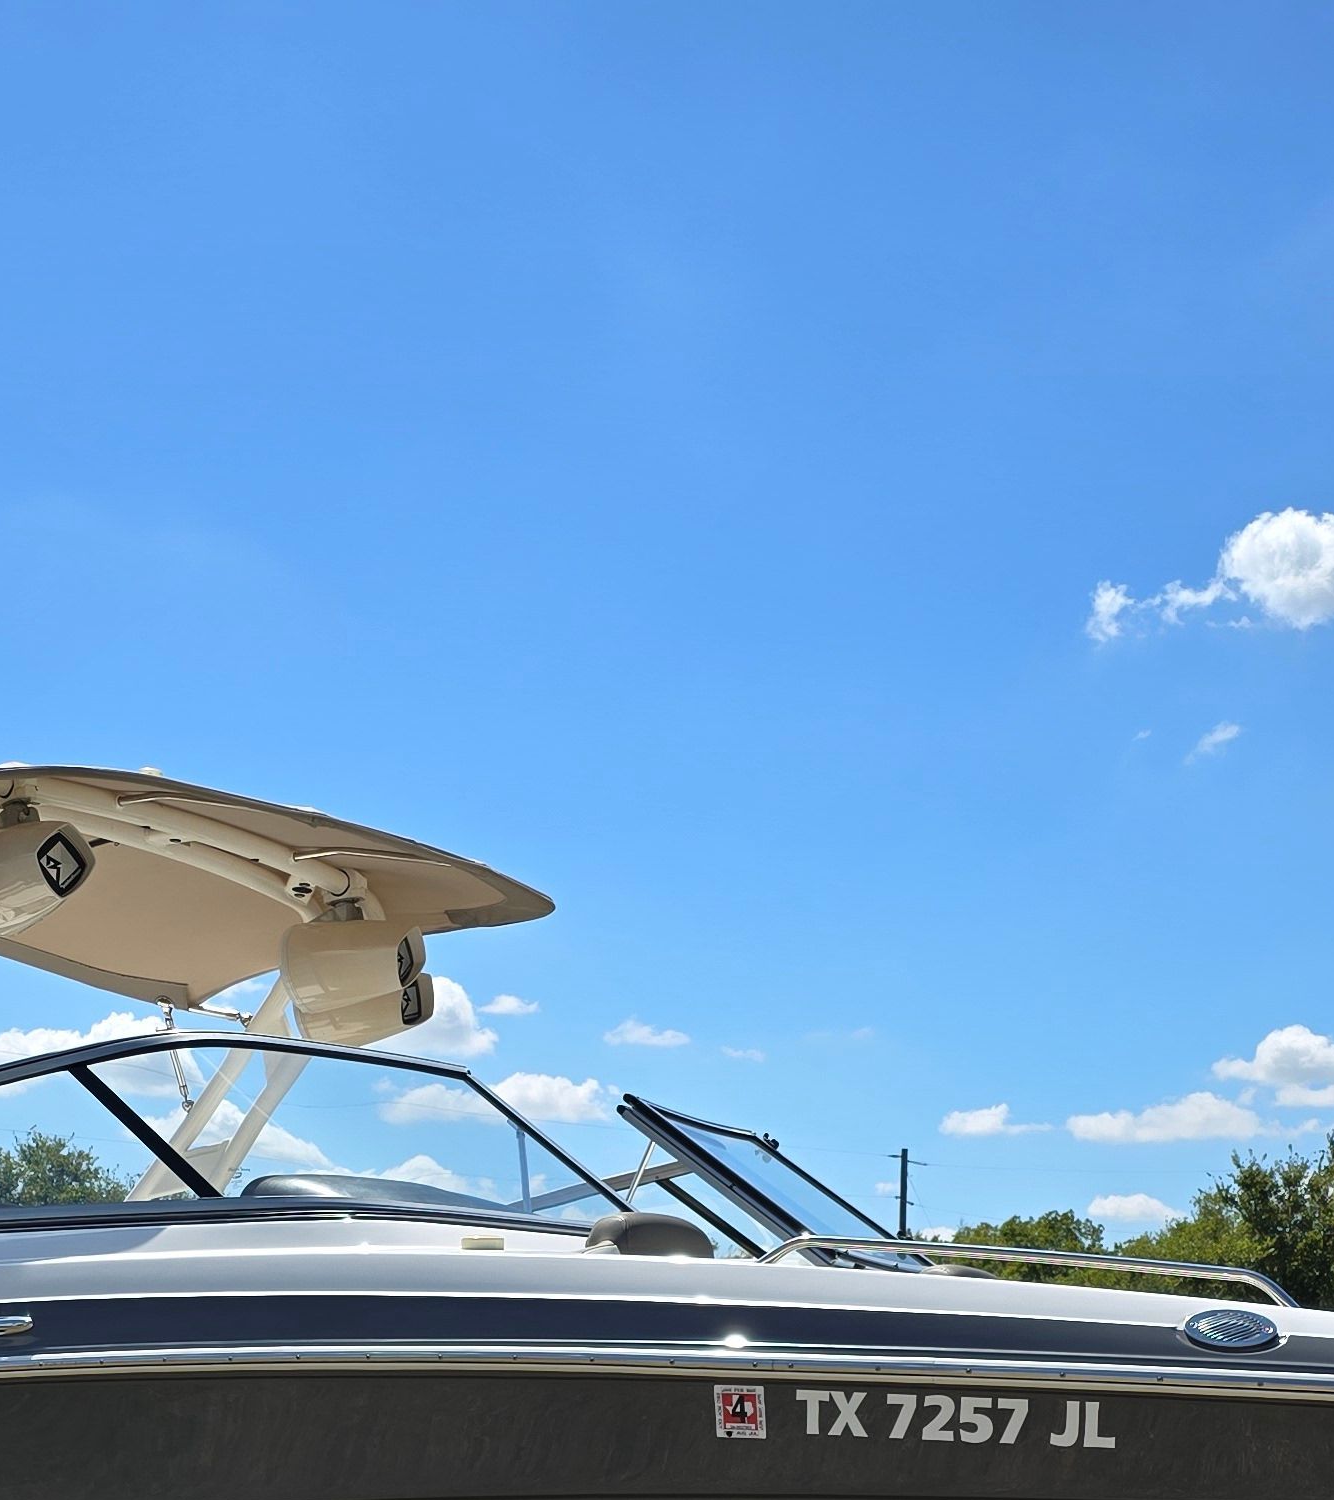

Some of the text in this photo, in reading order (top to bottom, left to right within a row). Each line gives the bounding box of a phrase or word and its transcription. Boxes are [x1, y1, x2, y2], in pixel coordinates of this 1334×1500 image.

[731, 1394, 748, 1424] 4
[795, 1389, 869, 1438] TX
[886, 1393, 1029, 1445] 7257
[1049, 1400, 1116, 1449] JL
